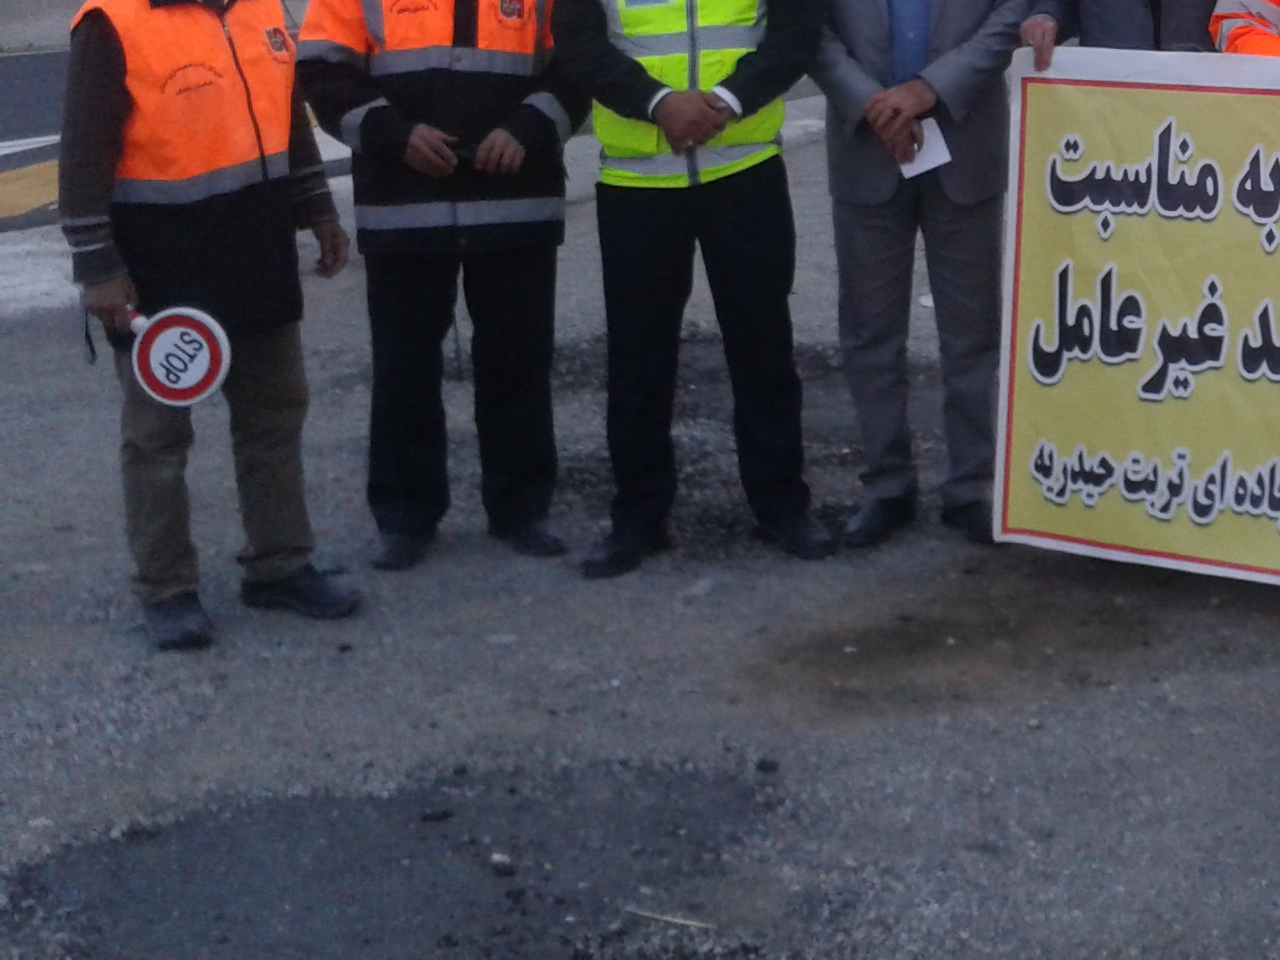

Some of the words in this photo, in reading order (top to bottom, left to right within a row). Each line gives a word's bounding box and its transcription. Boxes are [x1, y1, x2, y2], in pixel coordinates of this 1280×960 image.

[1048, 120, 1221, 235] مناسبت
[159, 331, 203, 384] STOP
[1030, 444, 1117, 509] حیدریه
[1120, 452, 1188, 515] تربت
[1190, 458, 1229, 520] ای
